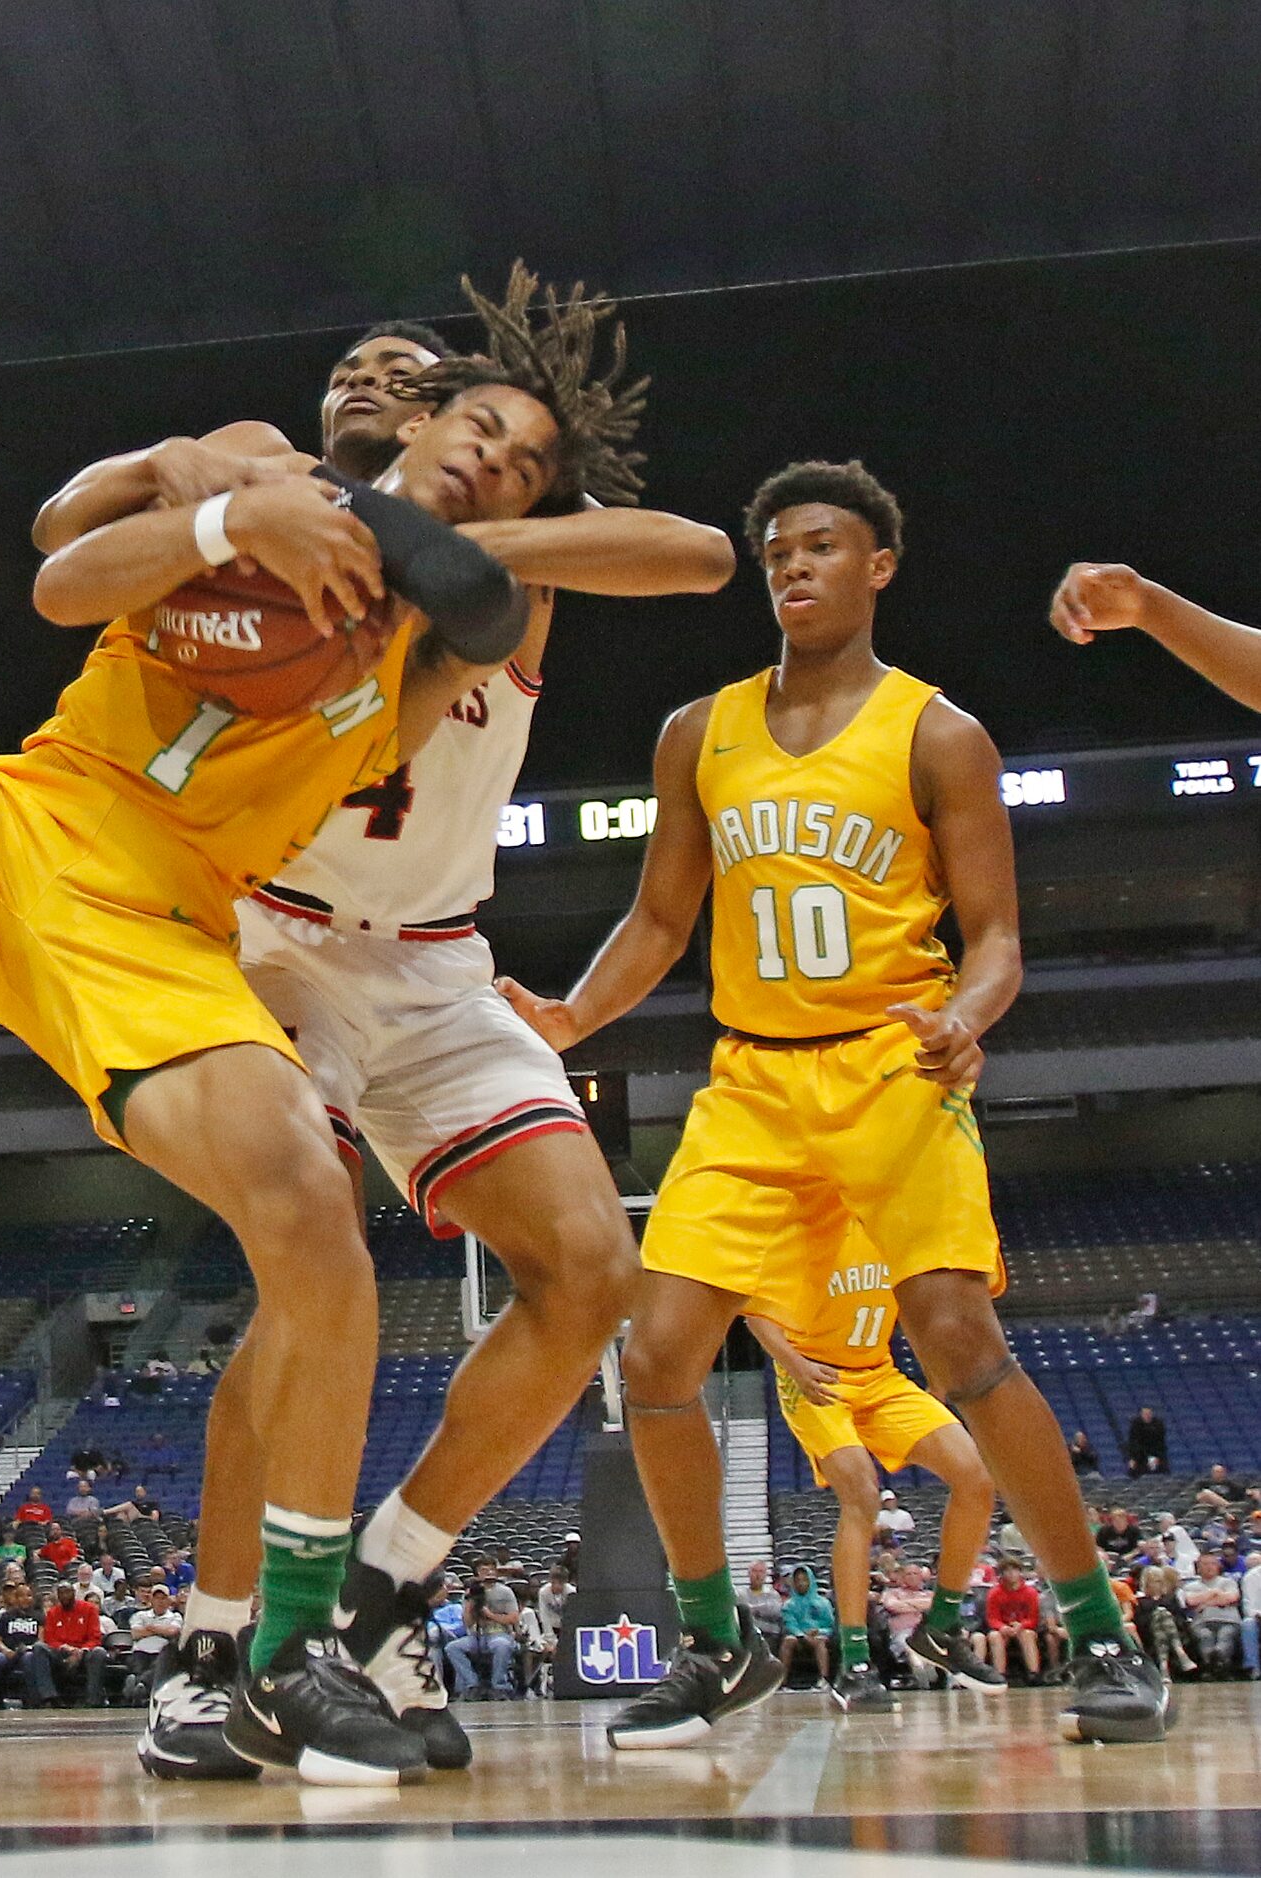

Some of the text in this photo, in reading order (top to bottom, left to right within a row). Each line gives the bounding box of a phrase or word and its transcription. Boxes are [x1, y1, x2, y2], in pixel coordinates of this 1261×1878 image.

[155, 604, 262, 652] SPALDI
[1001, 769, 1066, 807] SON
[1172, 777, 1235, 796] FOULS
[1174, 760, 1229, 778] TEAM
[496, 802, 546, 847] 31
[751, 884, 852, 980] 10
[847, 1306, 887, 1347] 11
